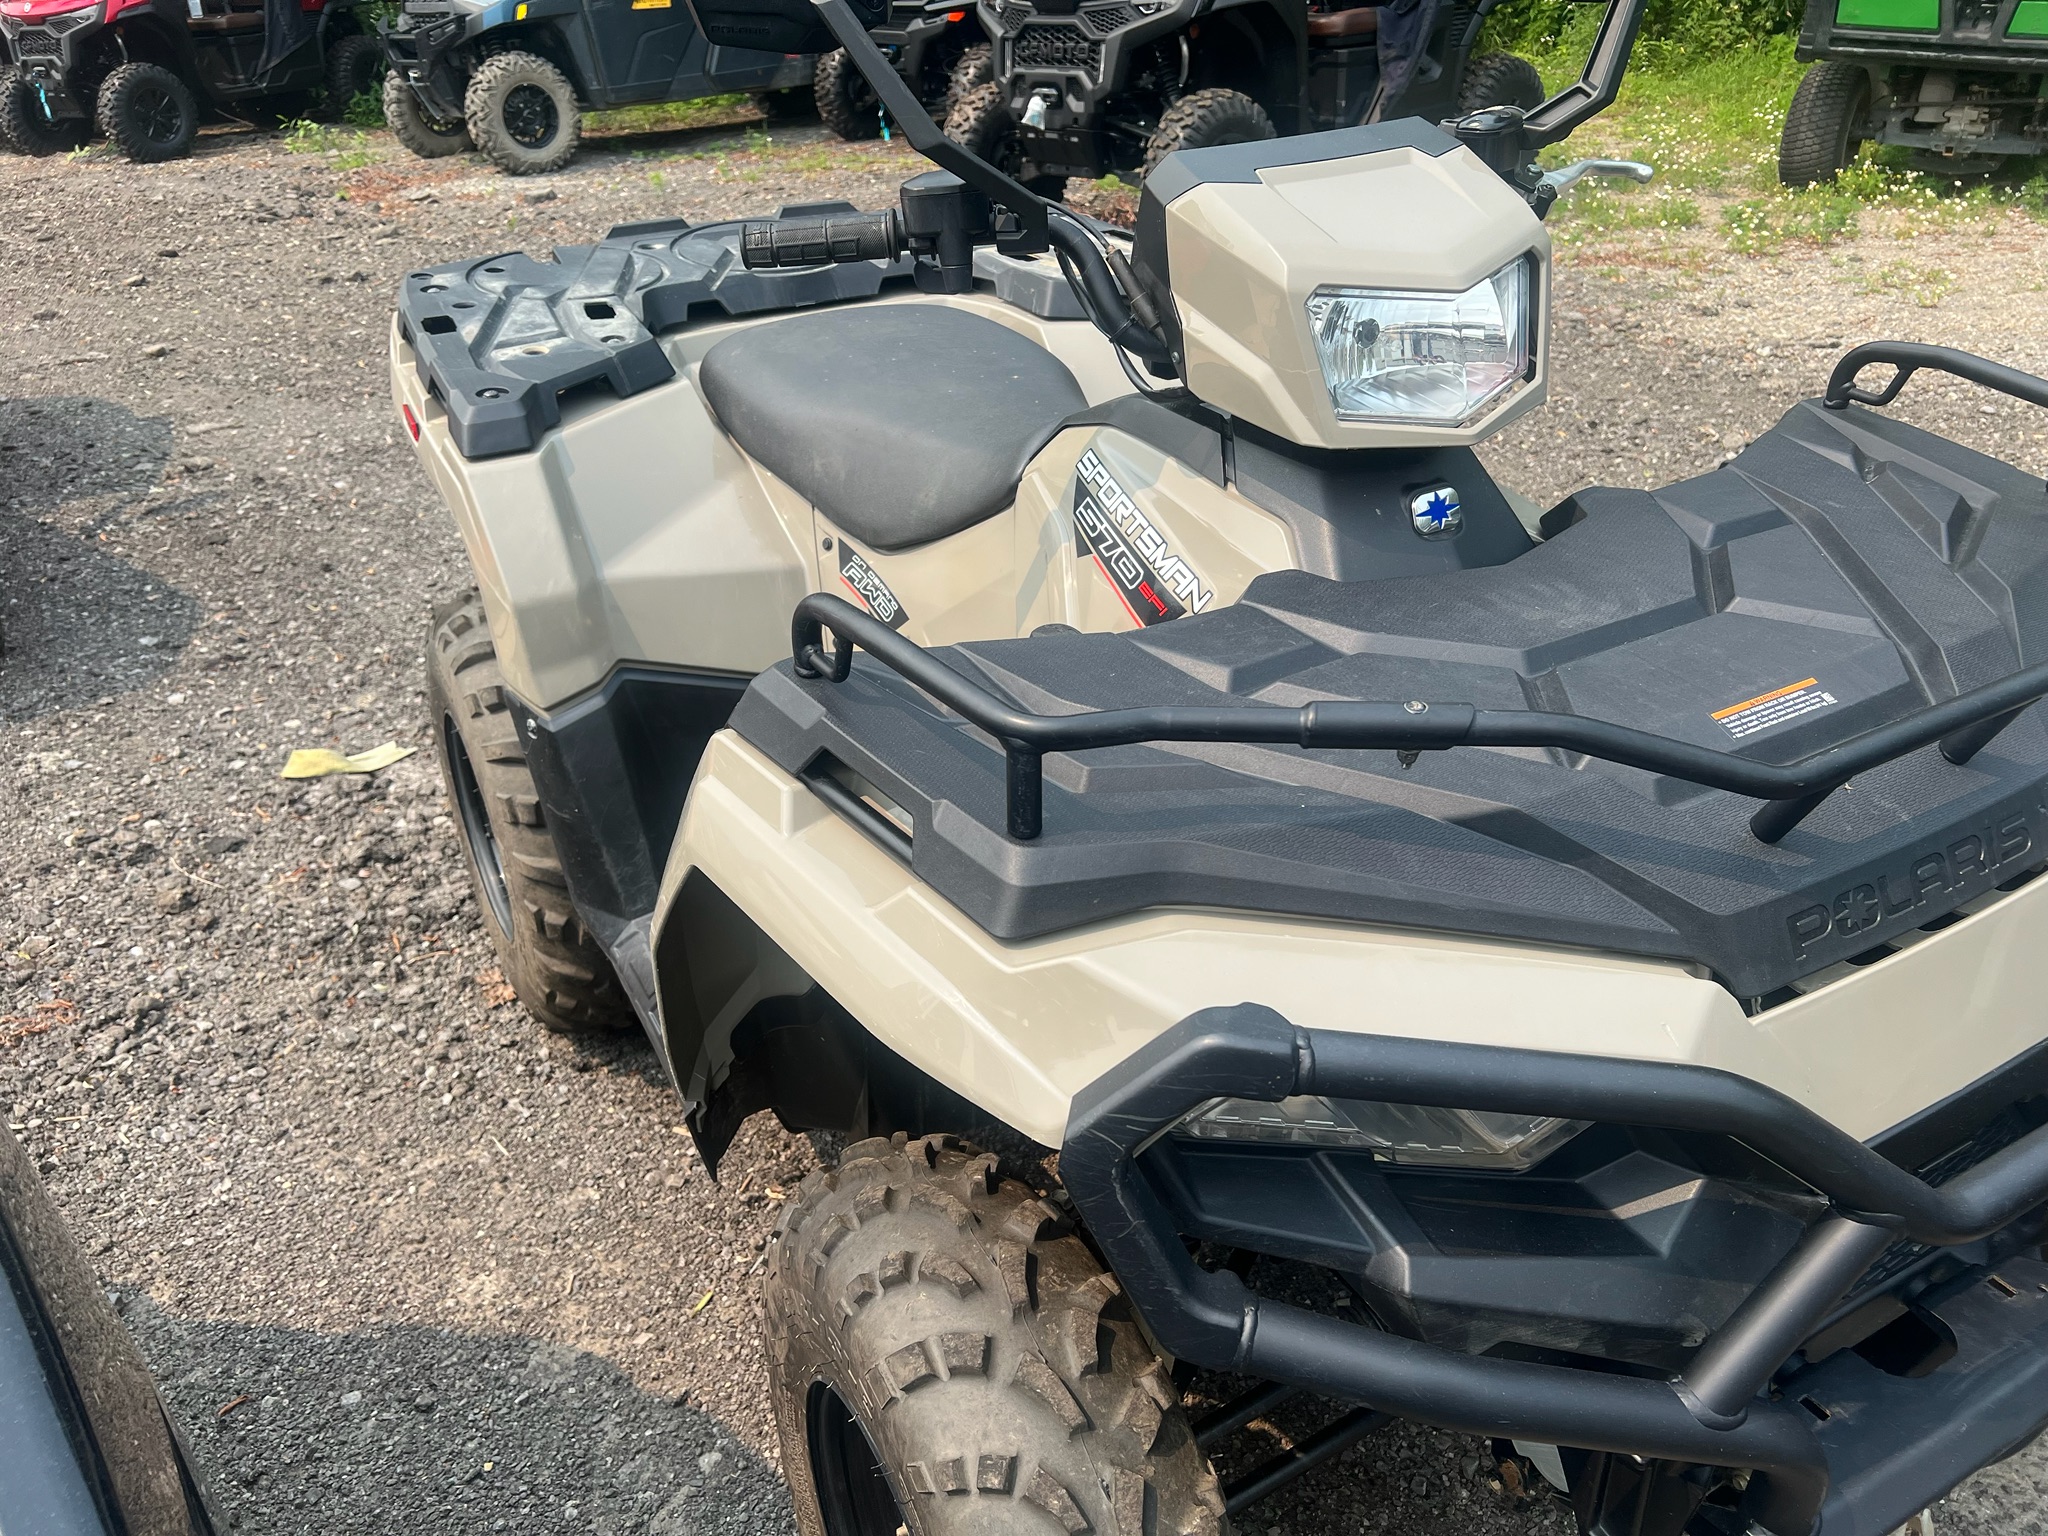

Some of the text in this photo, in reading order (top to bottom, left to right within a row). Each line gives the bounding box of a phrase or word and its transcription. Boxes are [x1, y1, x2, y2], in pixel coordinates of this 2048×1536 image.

[1075, 448, 1213, 614] SPORTSMAN
[1075, 497, 1168, 616] 570 EFI
[842, 562, 895, 622] AWD
[1754, 692, 1783, 704] WARNING
[1786, 811, 2032, 961] POLARIS
